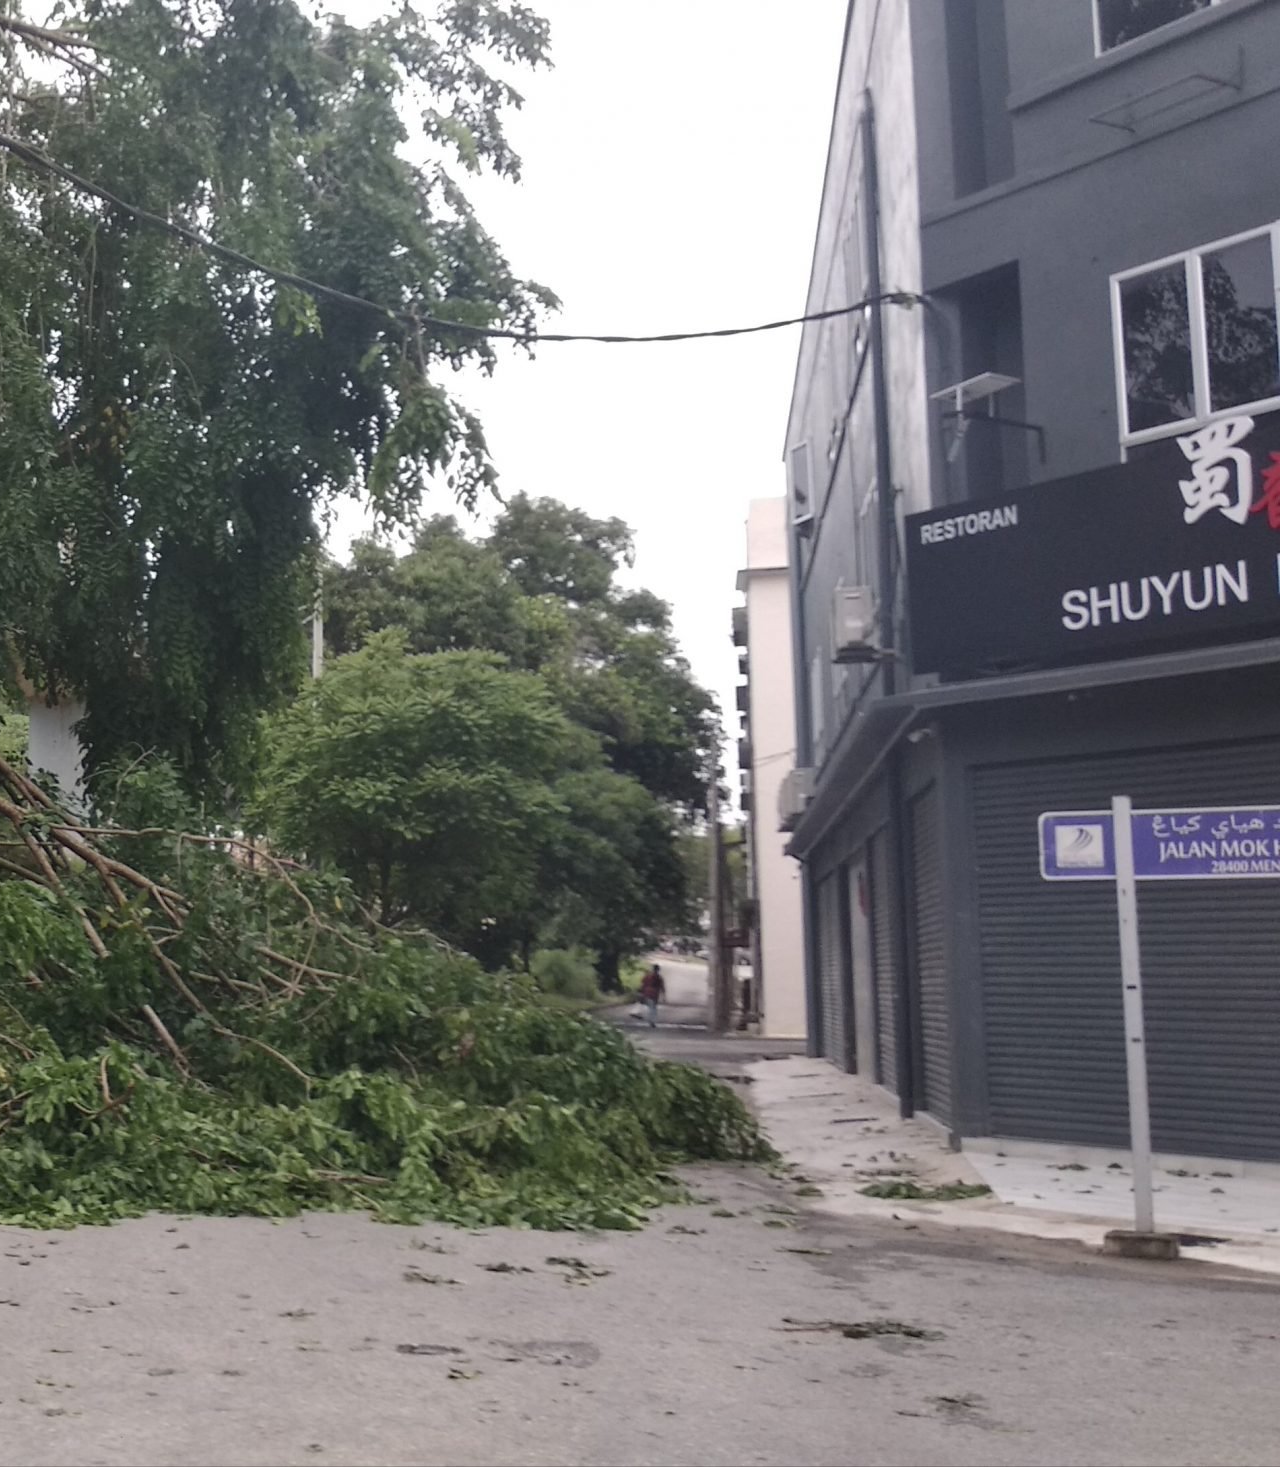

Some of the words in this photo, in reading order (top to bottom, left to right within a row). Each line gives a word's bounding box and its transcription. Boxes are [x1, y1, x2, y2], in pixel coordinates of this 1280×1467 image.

[921, 504, 1018, 545] RESTORAN
[1062, 560, 1249, 630] SHUYUN
[1159, 841, 1217, 863] JALAN
[1221, 839, 1270, 857] MOK
